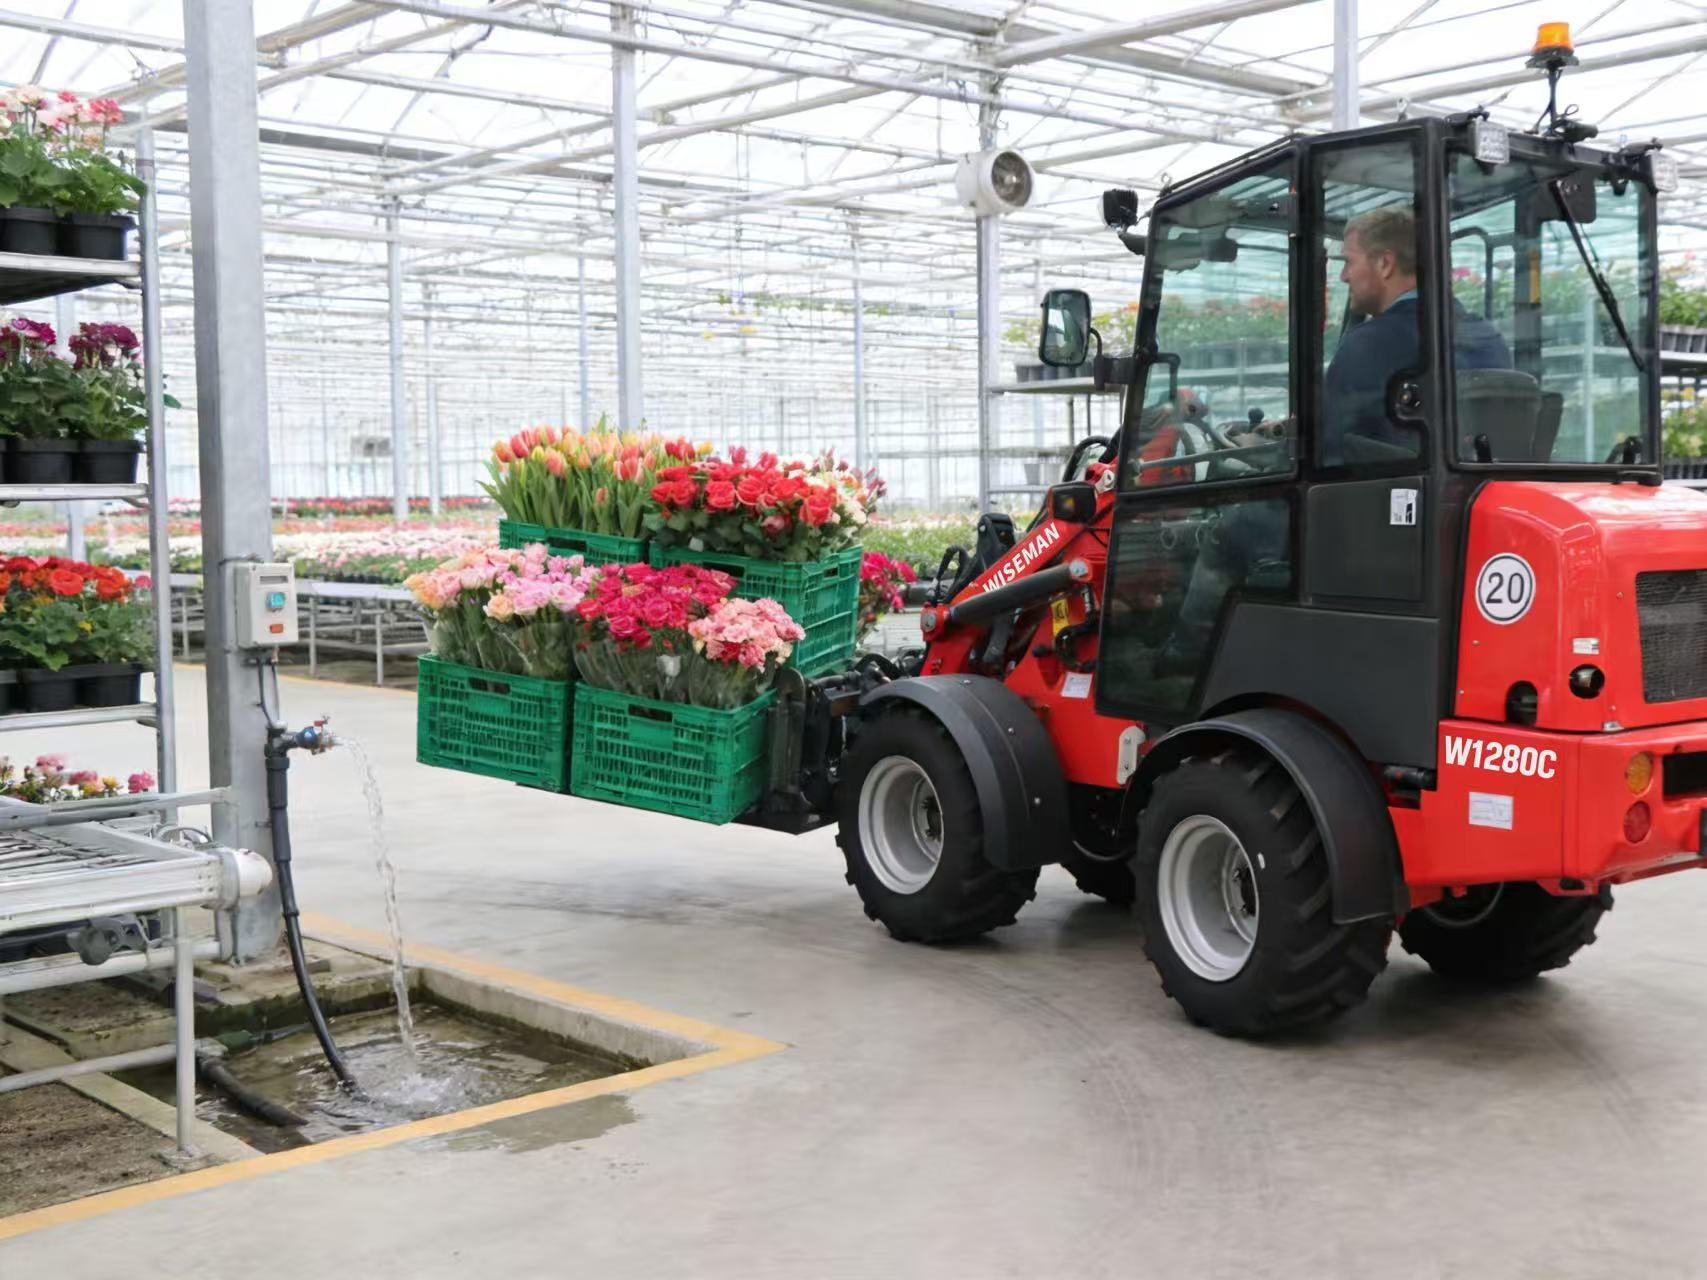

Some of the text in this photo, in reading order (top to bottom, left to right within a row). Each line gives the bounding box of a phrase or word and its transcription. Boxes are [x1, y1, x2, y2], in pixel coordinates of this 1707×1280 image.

[982, 522, 1061, 593] WISEMAN
[1486, 572, 1524, 604] 20
[1445, 735, 1557, 779] W1280C
